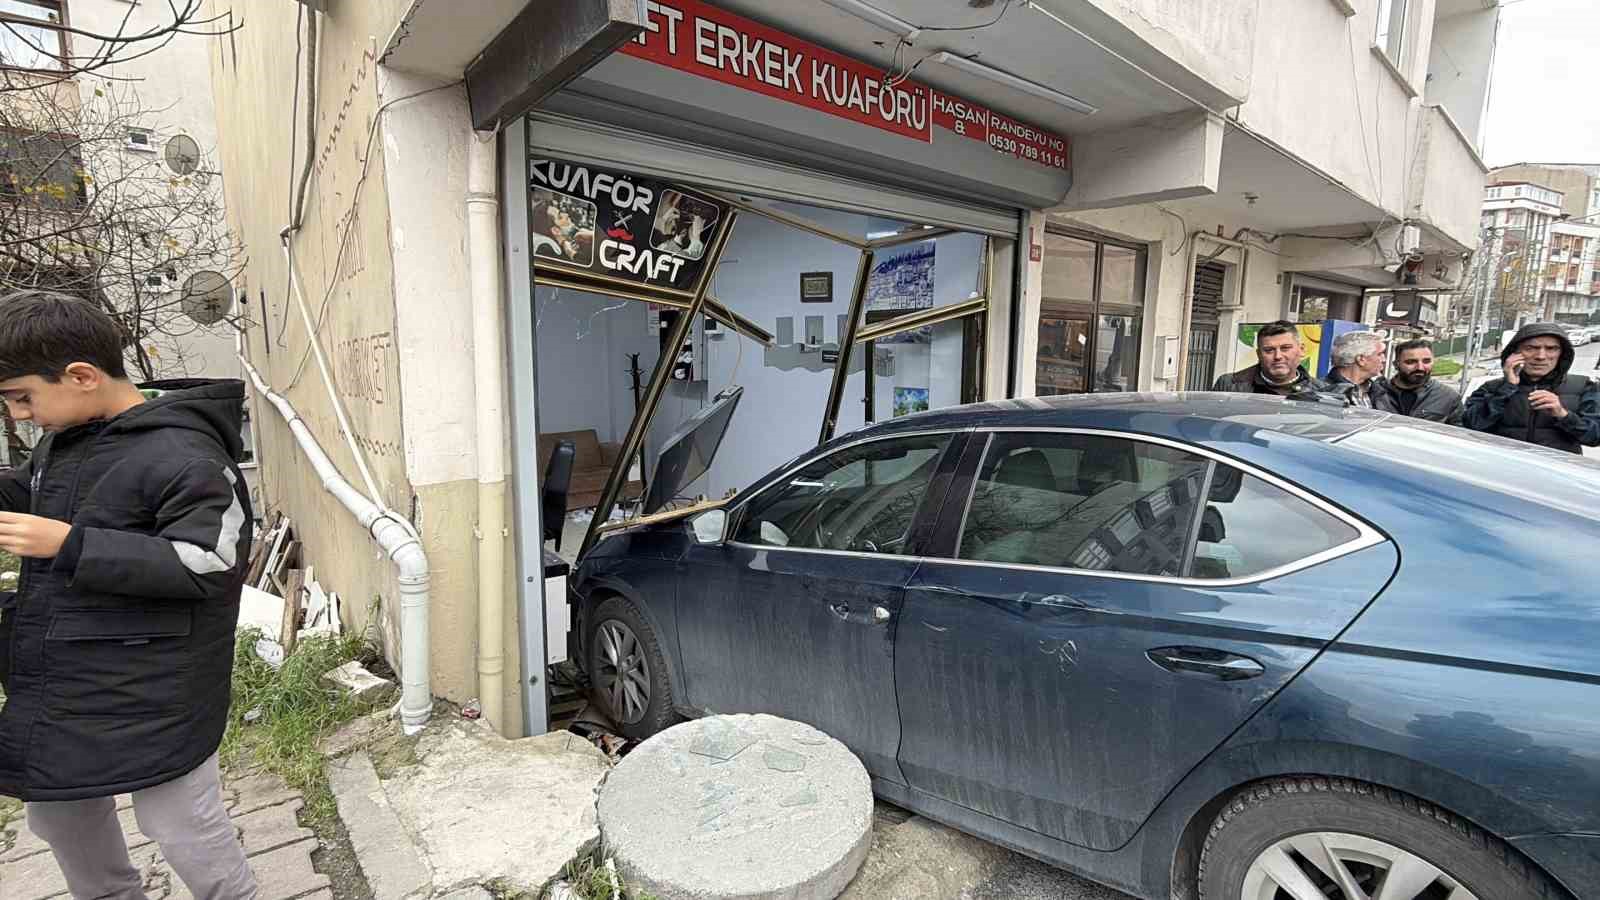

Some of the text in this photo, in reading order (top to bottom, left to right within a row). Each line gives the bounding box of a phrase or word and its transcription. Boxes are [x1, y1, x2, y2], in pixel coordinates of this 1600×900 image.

[631, 0, 926, 131] FT ERKEK KUAFÖRÜ
[933, 94, 986, 126] HASAN
[954, 119, 966, 135] &
[989, 133, 1065, 169] 0530 789 11 61
[991, 115, 1064, 152] RANDEVU NO
[530, 159, 654, 215] KUAFÖR
[600, 239, 685, 283] CRAFT
